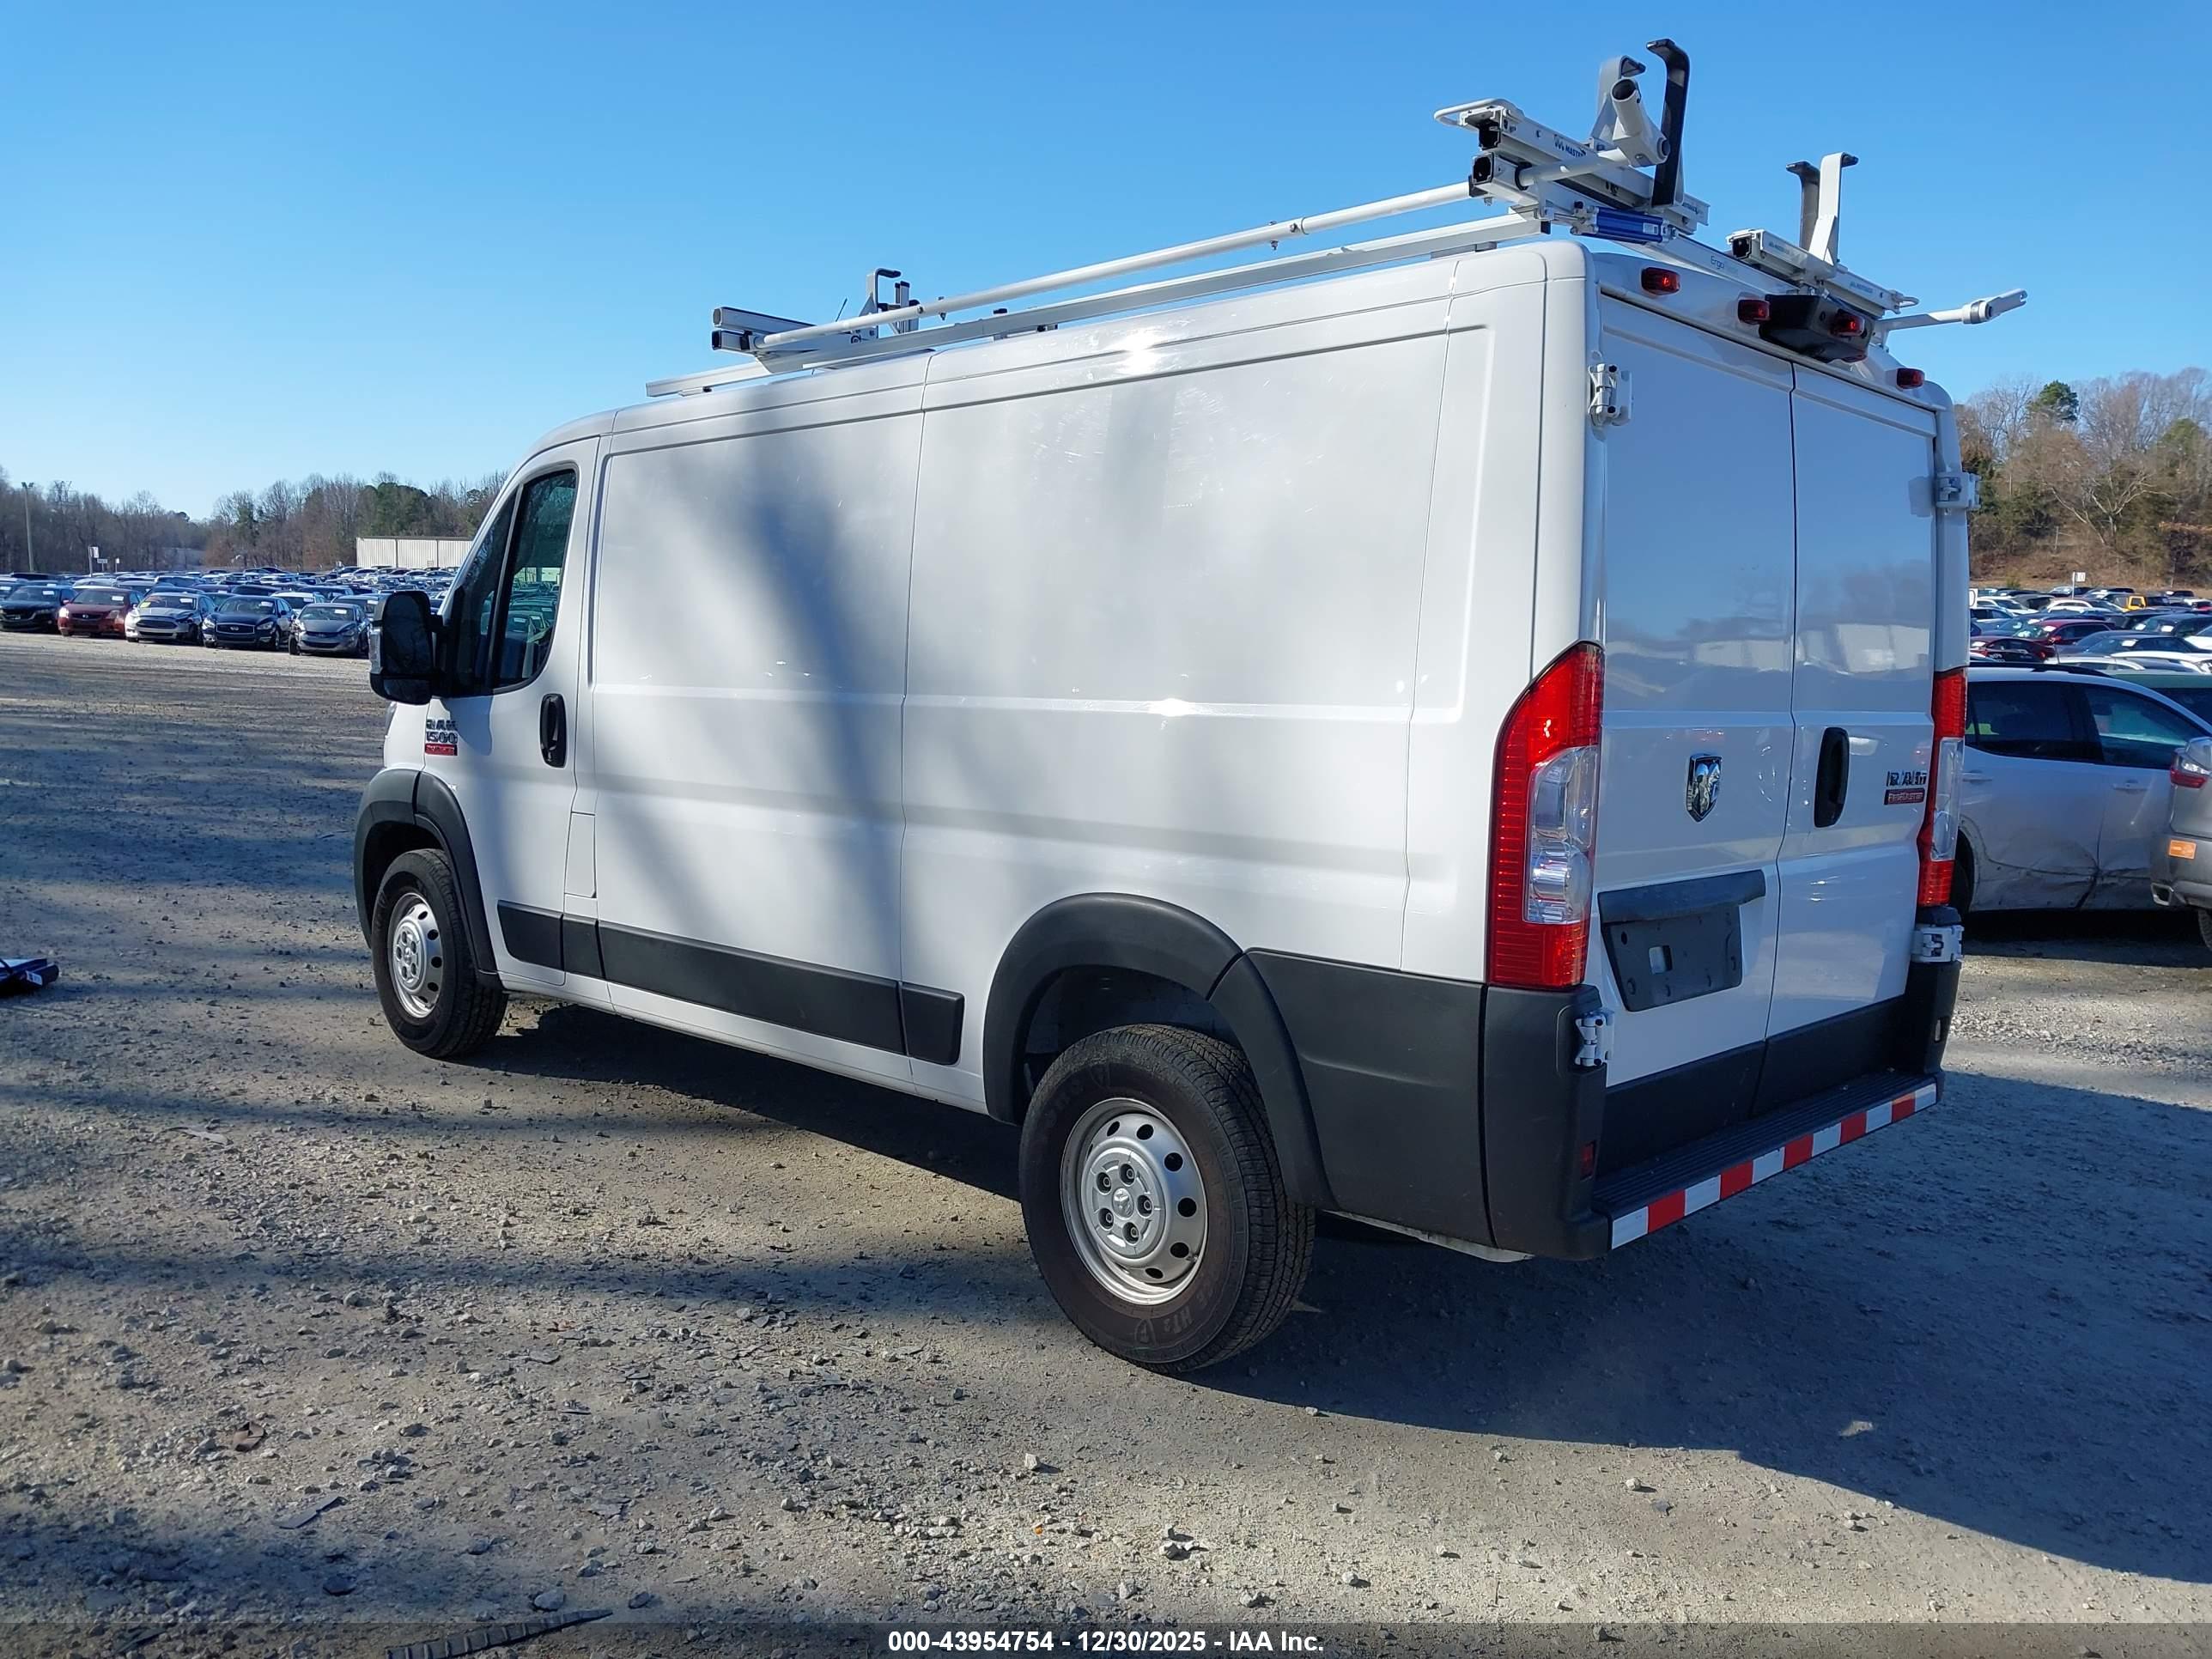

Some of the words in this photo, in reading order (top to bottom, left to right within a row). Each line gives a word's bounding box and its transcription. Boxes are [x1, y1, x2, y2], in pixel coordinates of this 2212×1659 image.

[426, 718, 457, 731] RAM
[426, 731, 459, 744] 1500
[1886, 770, 1927, 787] RAM
